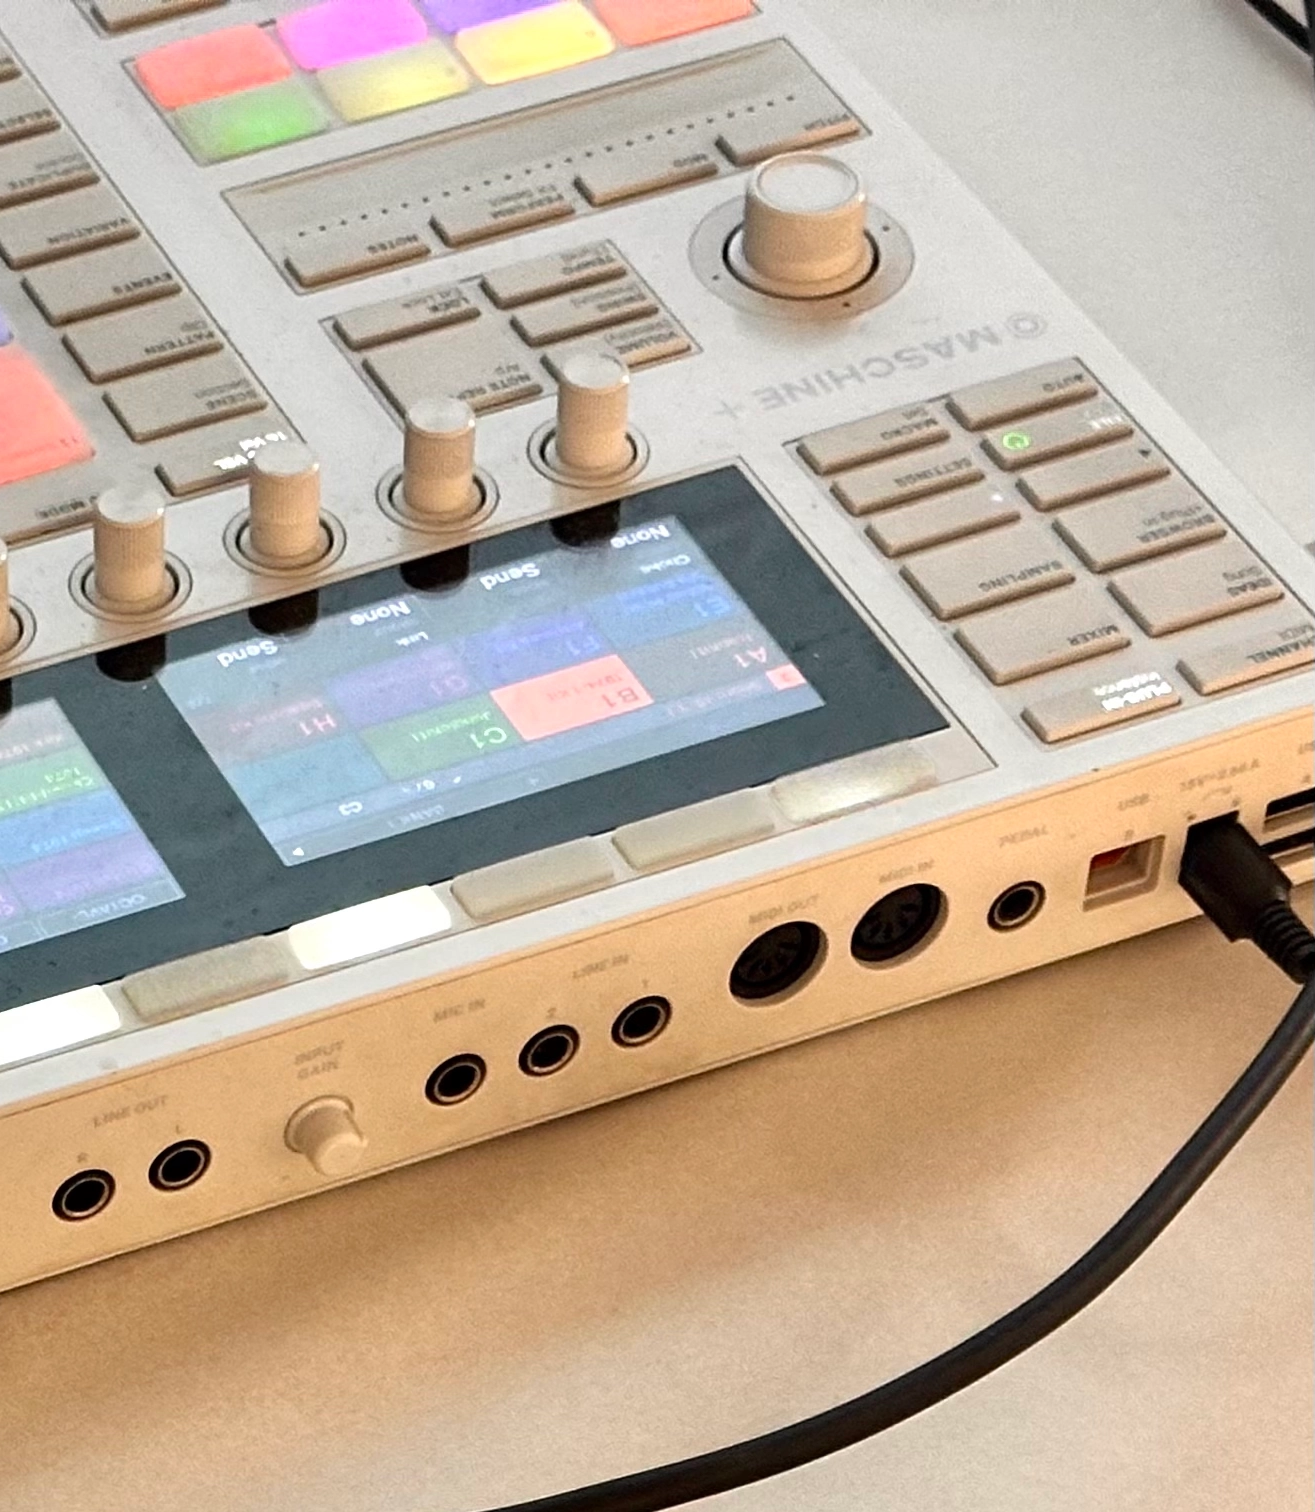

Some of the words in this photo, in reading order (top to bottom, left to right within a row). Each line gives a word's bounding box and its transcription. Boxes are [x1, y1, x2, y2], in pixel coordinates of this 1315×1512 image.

[45, 216, 129, 246] VARIATION
[366, 233, 418, 254] NOTES
[111, 270, 172, 295] EVENTS
[427, 296, 469, 314] LOCK
[144, 330, 214, 355] PATTERN
[615, 330, 677, 354] VOLUME
[489, 372, 531, 392] NOTE
[751, 328, 1000, 411] MASCHINE
[1042, 373, 1084, 393] AUTO
[205, 389, 257, 410] SCENE
[879, 417, 937, 440] MACRO
[893, 456, 971, 486] SETTINGS
[35, 498, 85, 520] MODE
[609, 522, 670, 552] None
[1135, 513, 1215, 544] BROWSER
[479, 560, 541, 591] Send
[976, 559, 1061, 592] SAMPLING
[1222, 563, 1261, 584] Song
[1226, 576, 1270, 597] IDEAS
[348, 599, 411, 630] None
[1066, 623, 1118, 646] MIXER
[216, 638, 278, 669] Send
[733, 645, 769, 670] A1
[600, 684, 639, 709] B1
[297, 711, 337, 737] H1
[468, 724, 506, 750] C1
[783, 894, 820, 916] OUT
[433, 1004, 465, 1023] MIC
[133, 1095, 169, 1118] OUT
